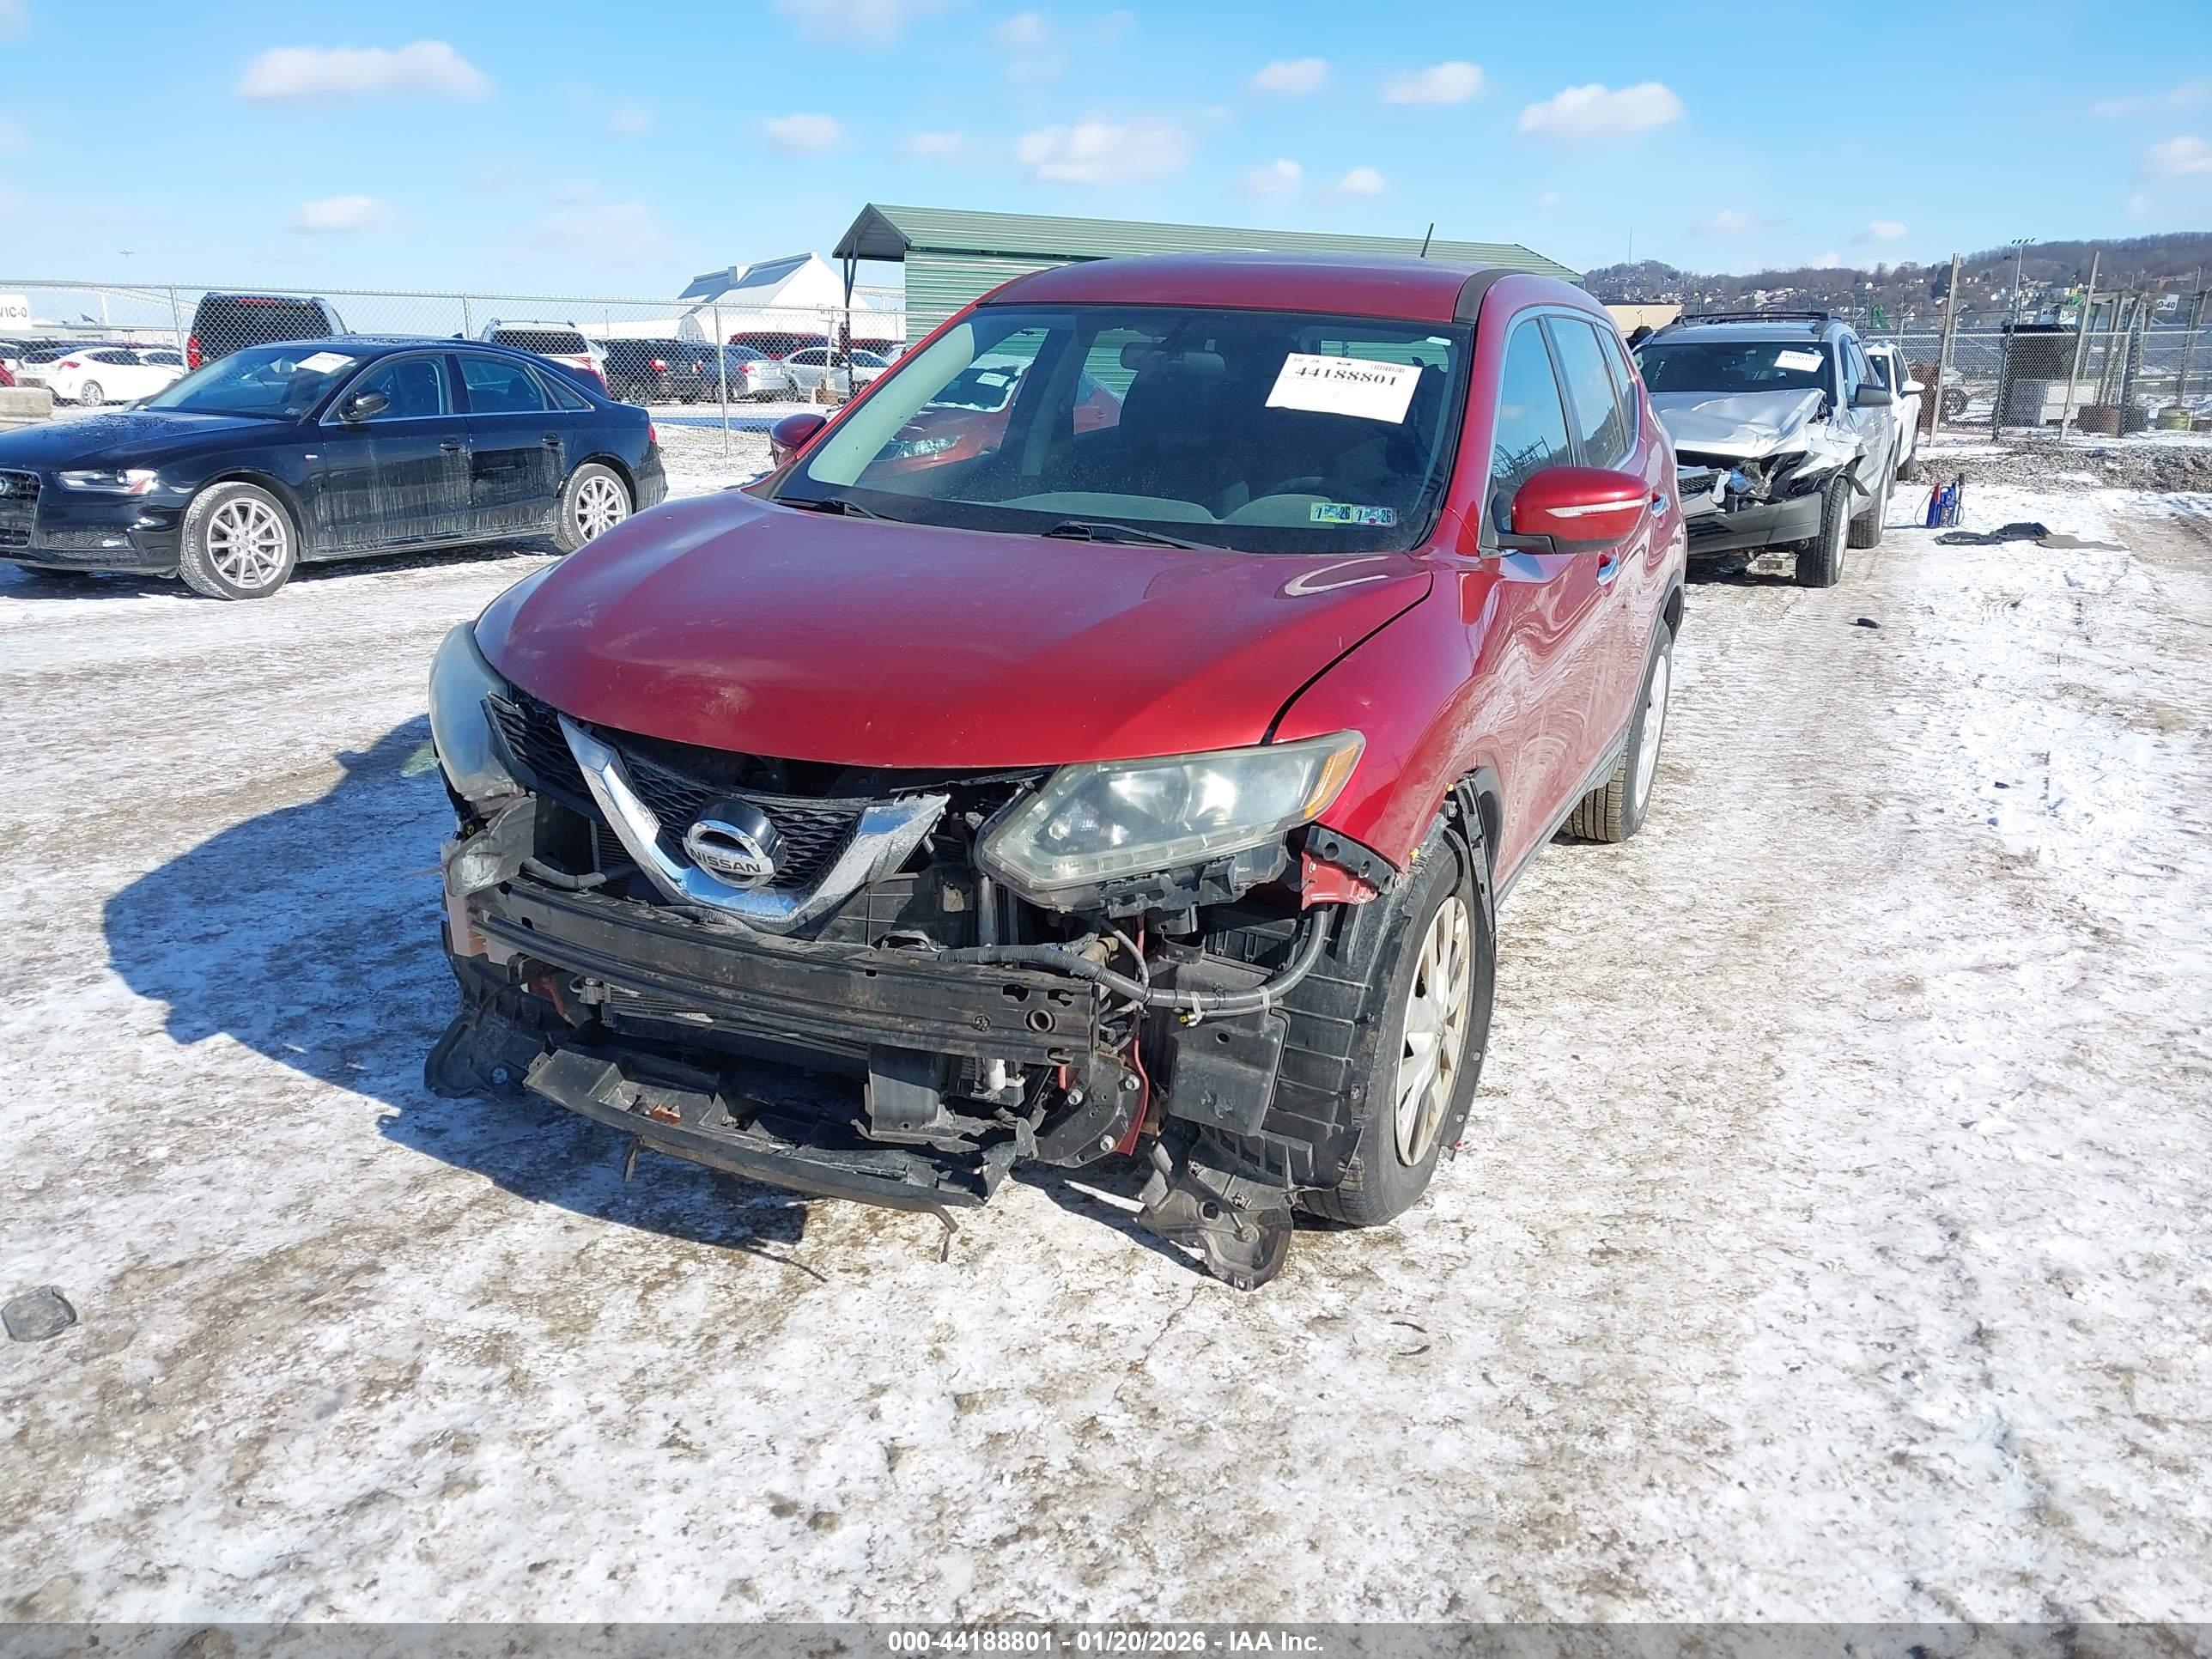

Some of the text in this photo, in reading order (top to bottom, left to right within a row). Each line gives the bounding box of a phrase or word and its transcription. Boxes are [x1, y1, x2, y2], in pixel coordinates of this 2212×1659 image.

[1294, 367, 1397, 386] 44188801
[1316, 506, 1351, 520] 7 26
[1357, 509, 1392, 524] 7 26
[690, 847, 763, 873] NISSAN
